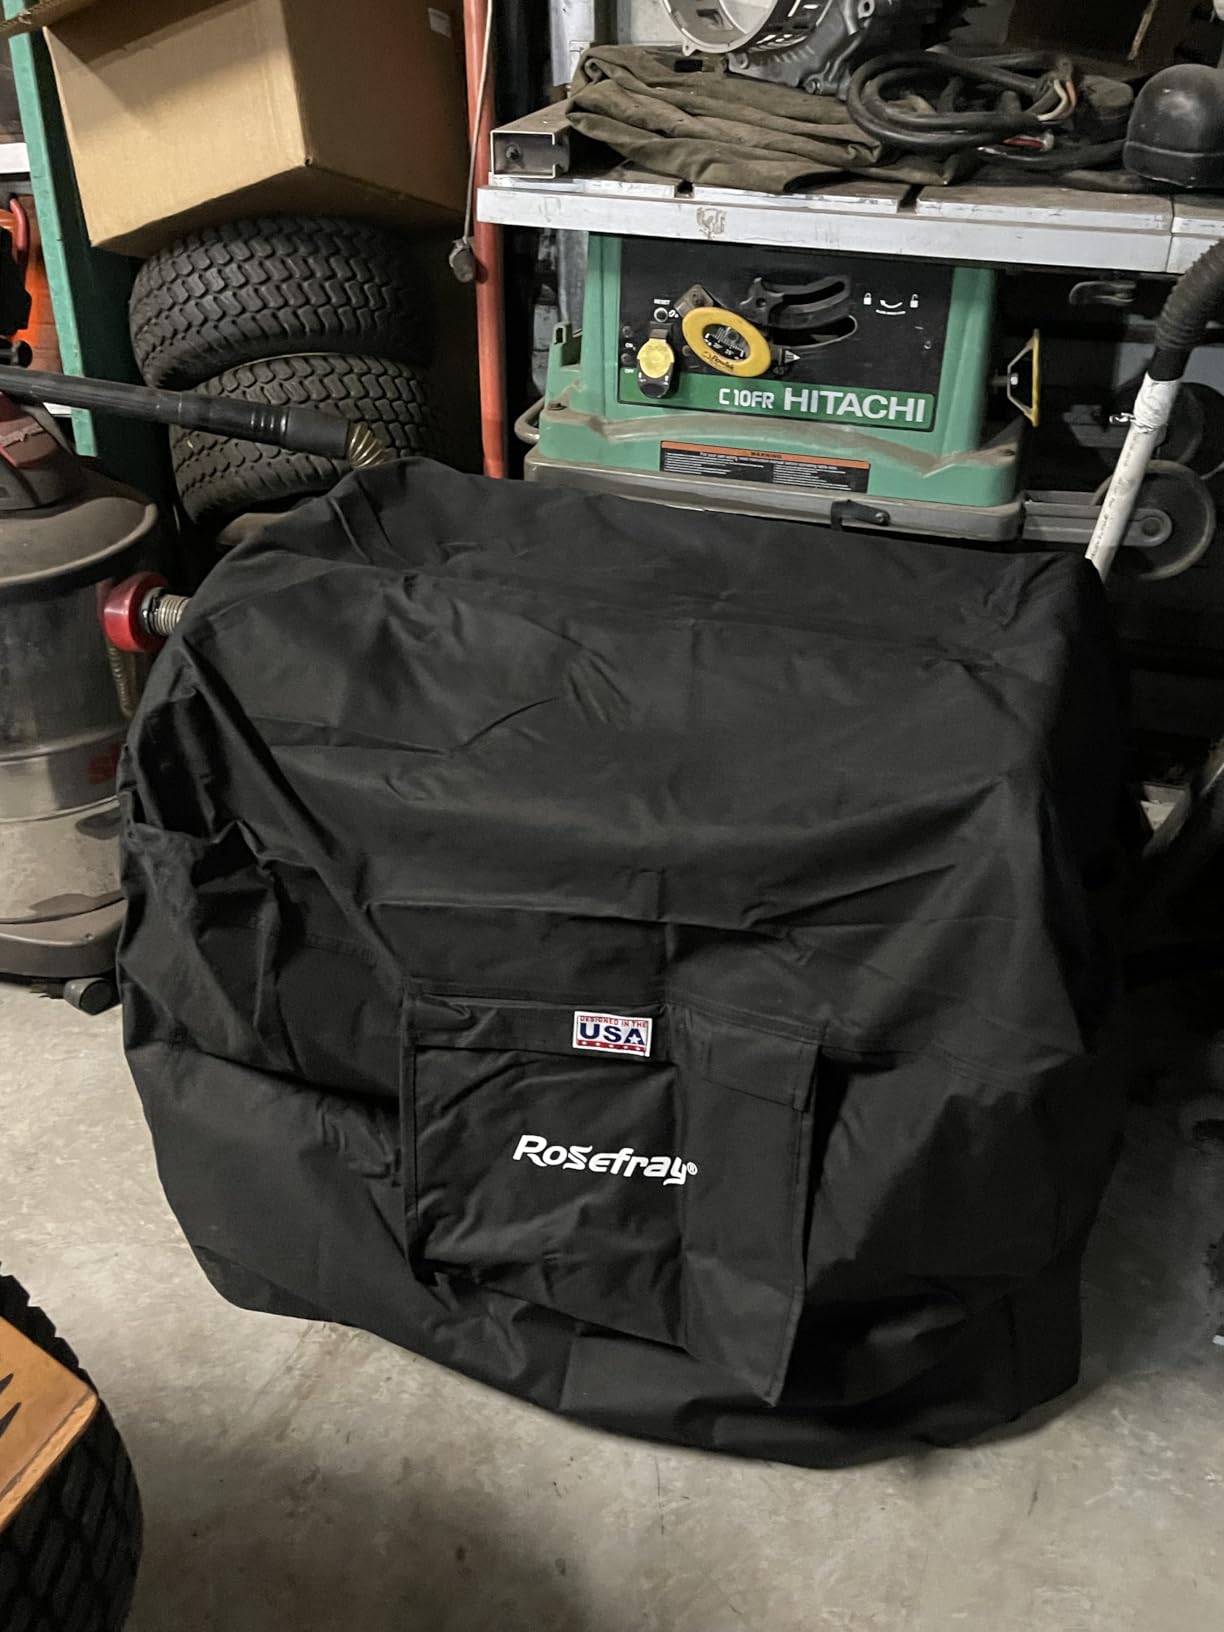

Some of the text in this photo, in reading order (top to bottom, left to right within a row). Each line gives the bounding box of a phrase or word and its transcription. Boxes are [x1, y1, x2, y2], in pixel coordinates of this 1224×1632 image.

[784, 387, 925, 422] HITACHI
[580, 1015, 619, 1025] DESIGNED
[580, 1023, 645, 1046] USA
